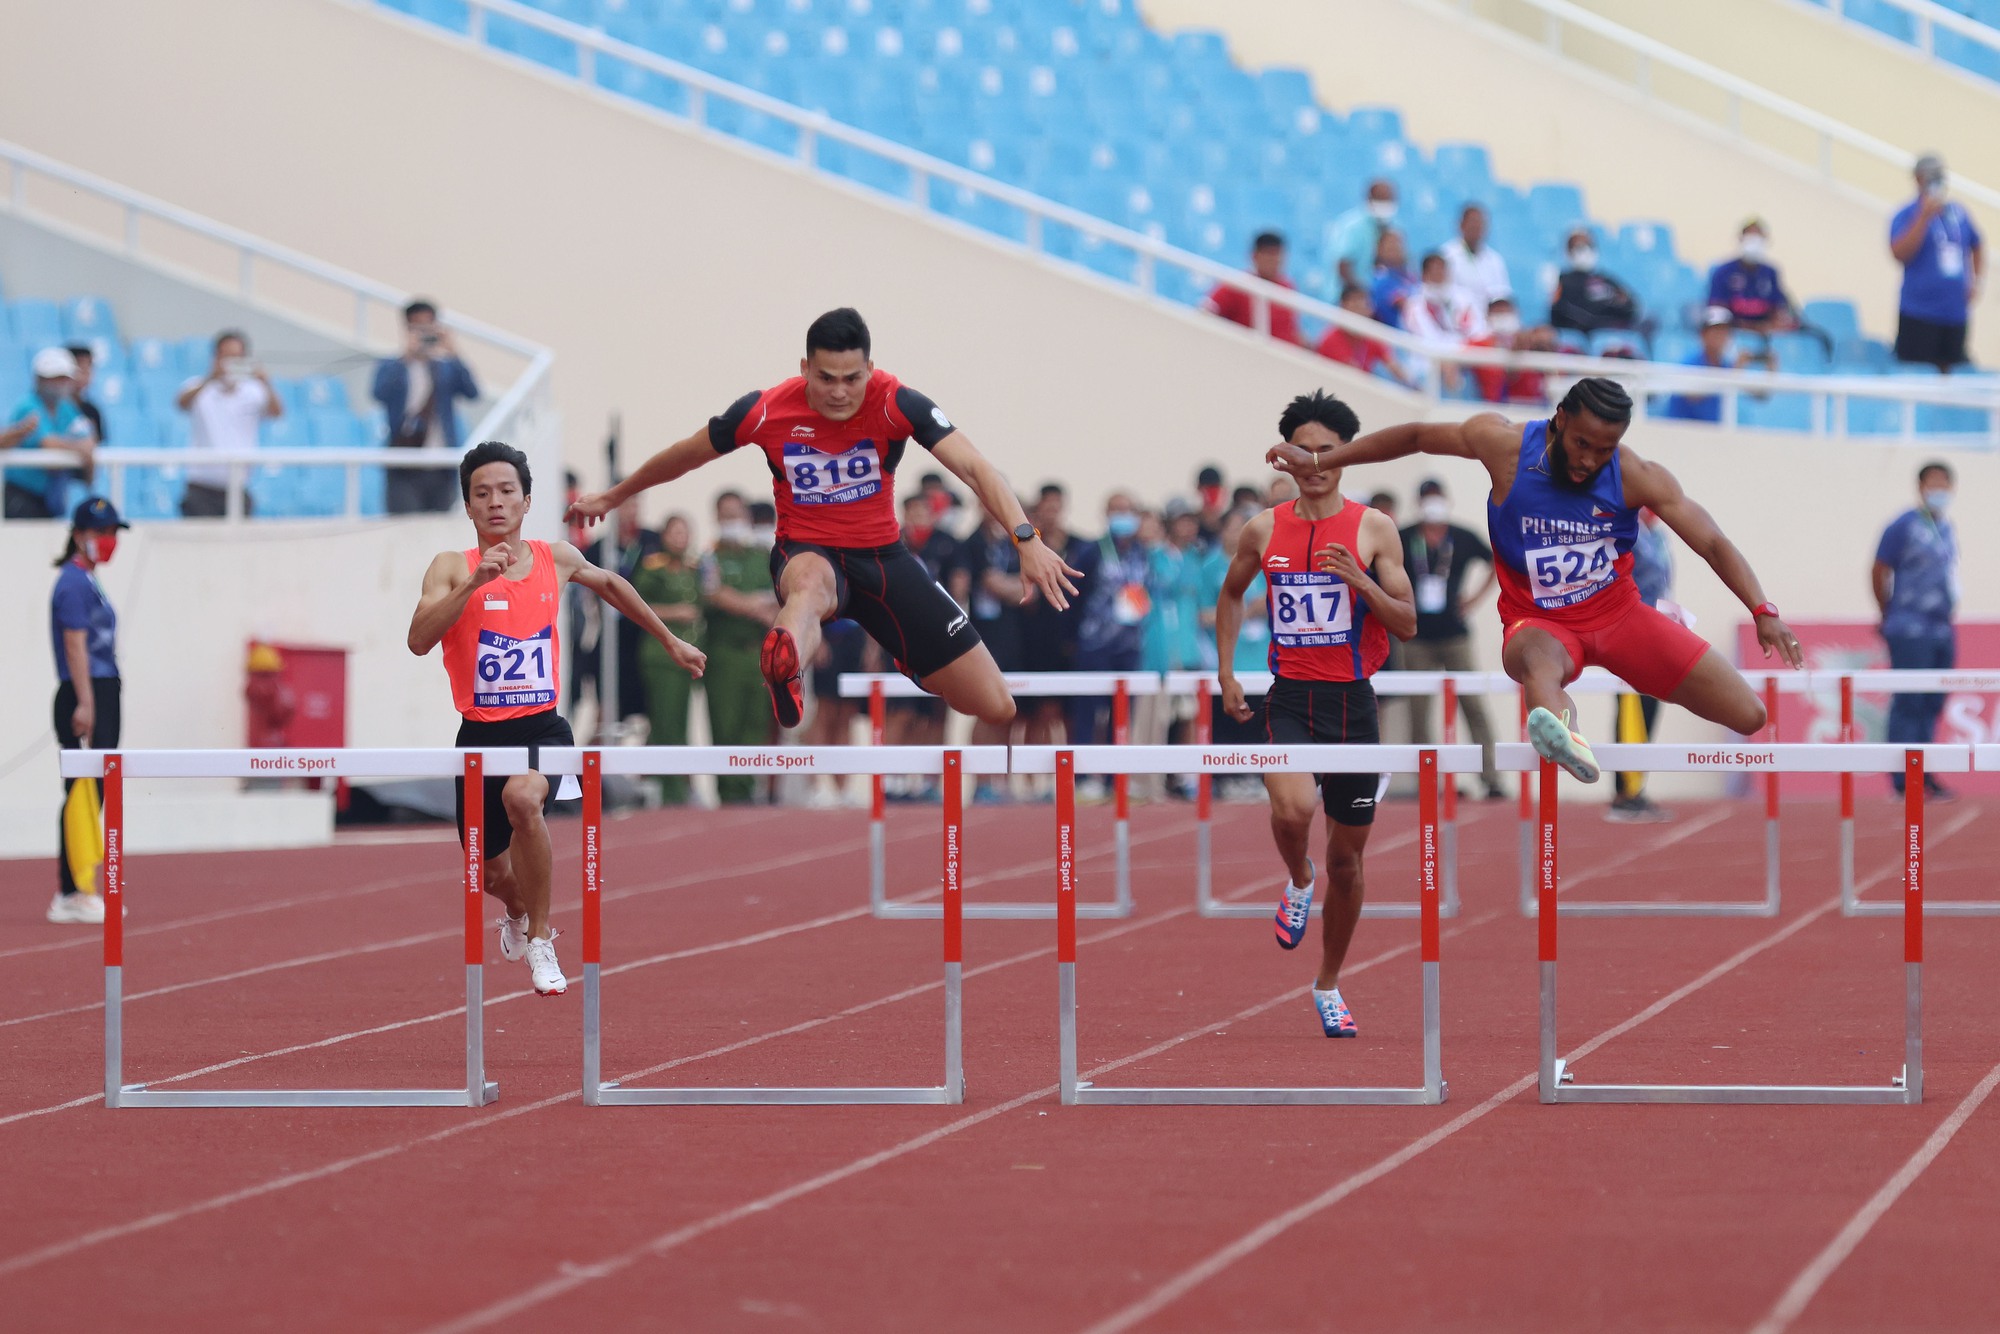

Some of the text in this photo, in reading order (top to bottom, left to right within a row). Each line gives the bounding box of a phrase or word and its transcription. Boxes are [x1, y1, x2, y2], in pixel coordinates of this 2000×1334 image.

[793, 456, 872, 490] 818
[860, 483, 876, 497] 2022
[1558, 534, 1573, 544] SEA
[1294, 574, 1308, 584] SEA
[1309, 574, 1331, 584] Games
[1536, 545, 1610, 587] 524
[1278, 591, 1341, 623] 817
[1570, 583, 1599, 604] VIETNAM
[1300, 634, 1330, 645] VIETNAM
[1331, 632, 1347, 644] 2022
[478, 647, 545, 682] 621
[479, 695, 500, 705] HANOI
[505, 693, 536, 704] VIETNAM
[537, 692, 551, 702] 2022
[297, 757, 336, 772] Sport
[776, 754, 815, 770] Sport
[1250, 753, 1289, 768] Sport
[1735, 752, 1774, 767] Sport
[107, 864, 119, 895] Sport
[468, 862, 480, 893] Sport
[585, 861, 597, 892] Sport
[946, 861, 958, 891] Sport
[1059, 860, 1071, 891] Sport
[1423, 860, 1436, 891] Sport
[1542, 859, 1554, 890] Sport
[1908, 860, 1920, 891] Sport
